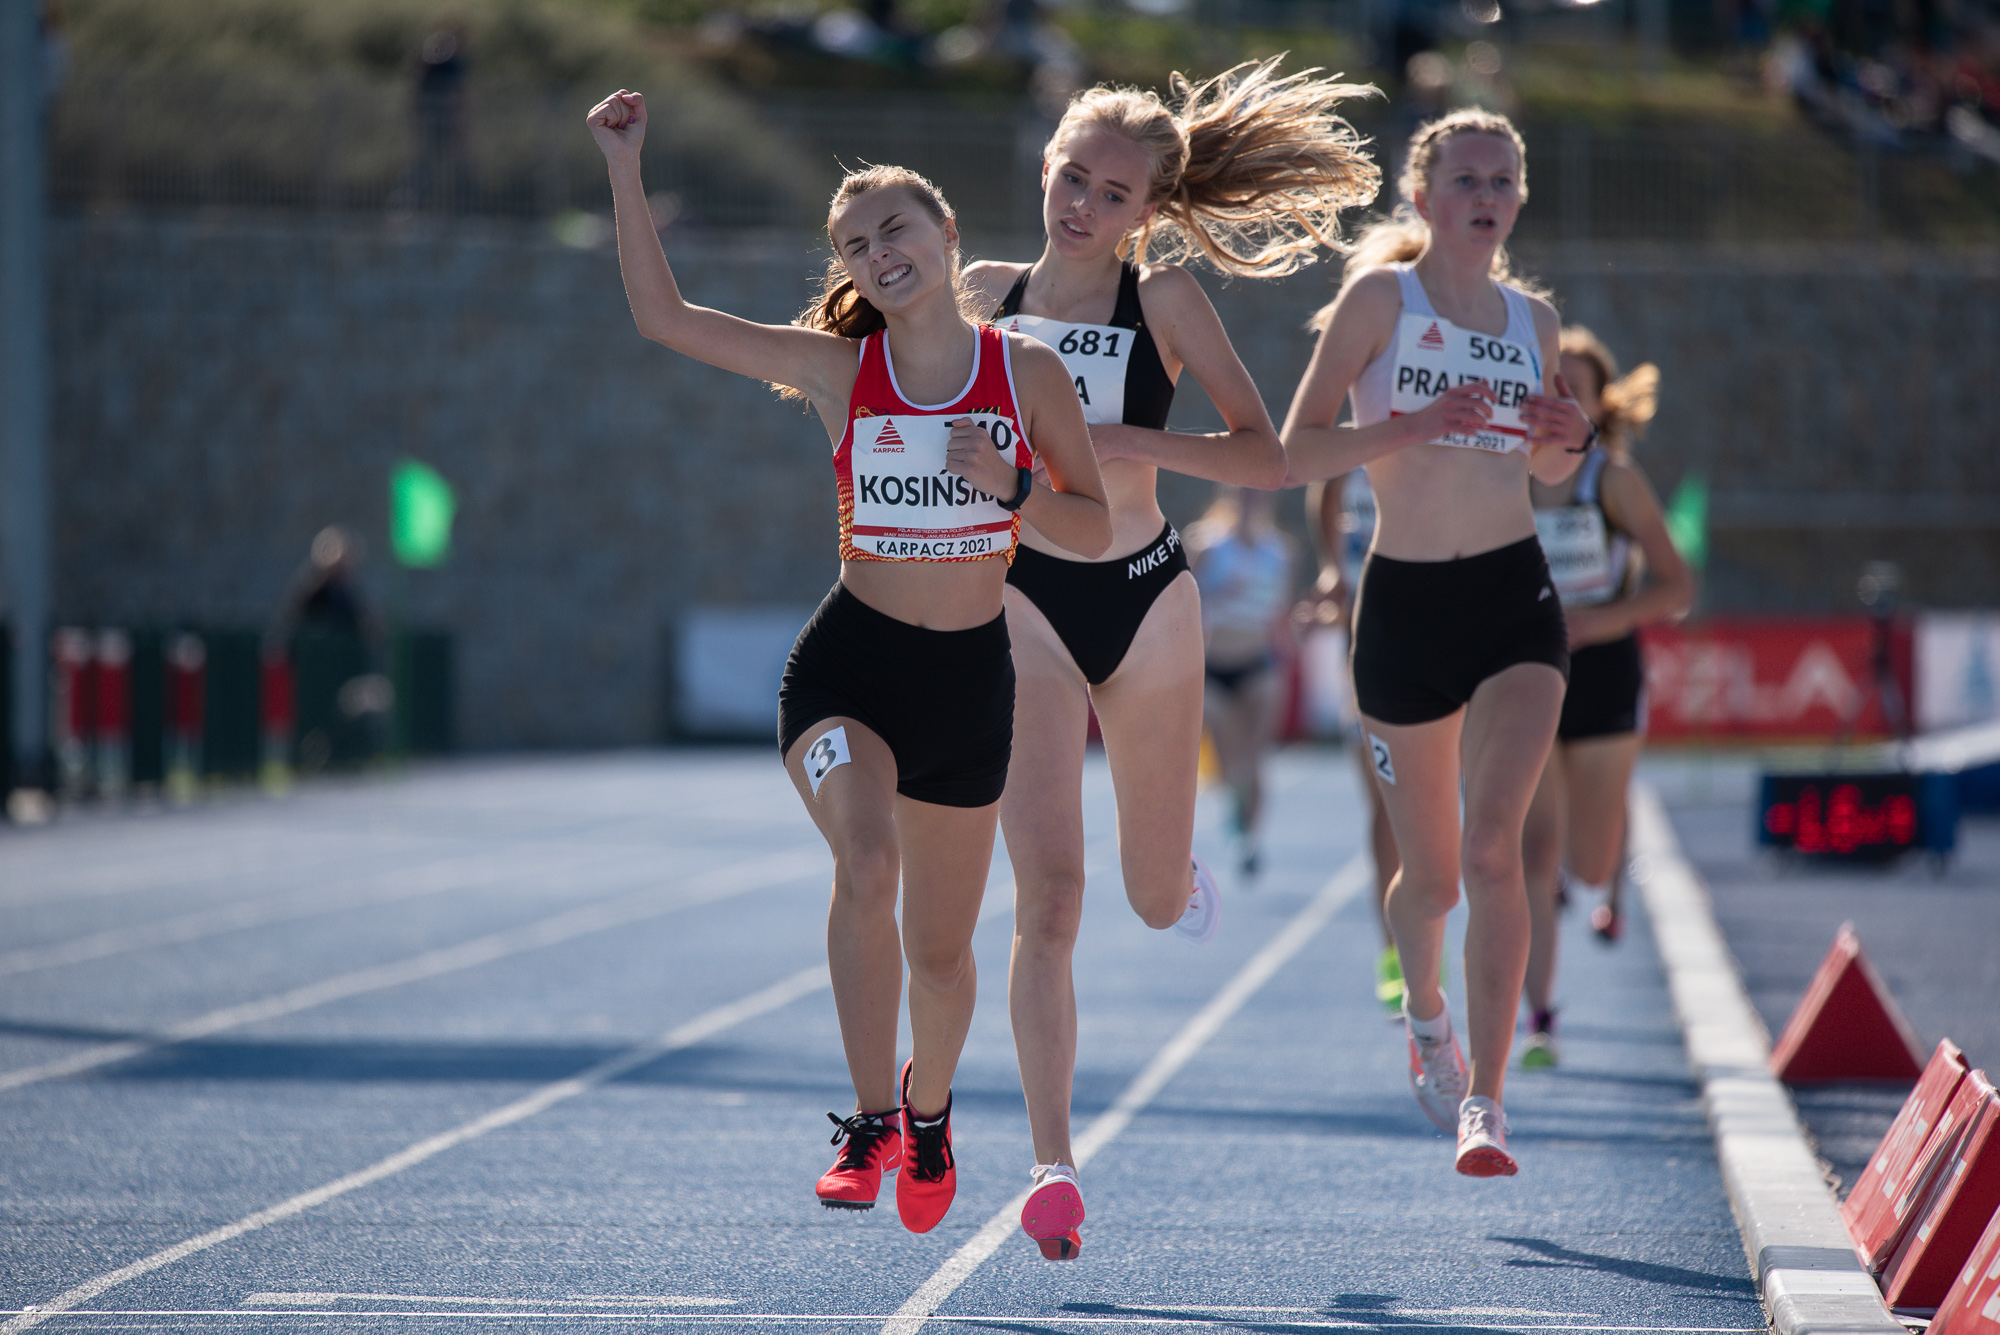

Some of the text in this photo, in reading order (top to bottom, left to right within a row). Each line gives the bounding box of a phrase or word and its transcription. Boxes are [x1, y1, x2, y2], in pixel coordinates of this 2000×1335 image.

[1058, 329, 1121, 358] 681
[1468, 336, 1526, 366] 502
[1473, 433, 1506, 451] 2021
[859, 469, 998, 507] KOSIŃSK
[876, 537, 993, 557] KARPACZ 2021
[1128, 523, 1181, 580] NIKE PR
[811, 738, 836, 779] 3
[1375, 745, 1392, 777] 2
